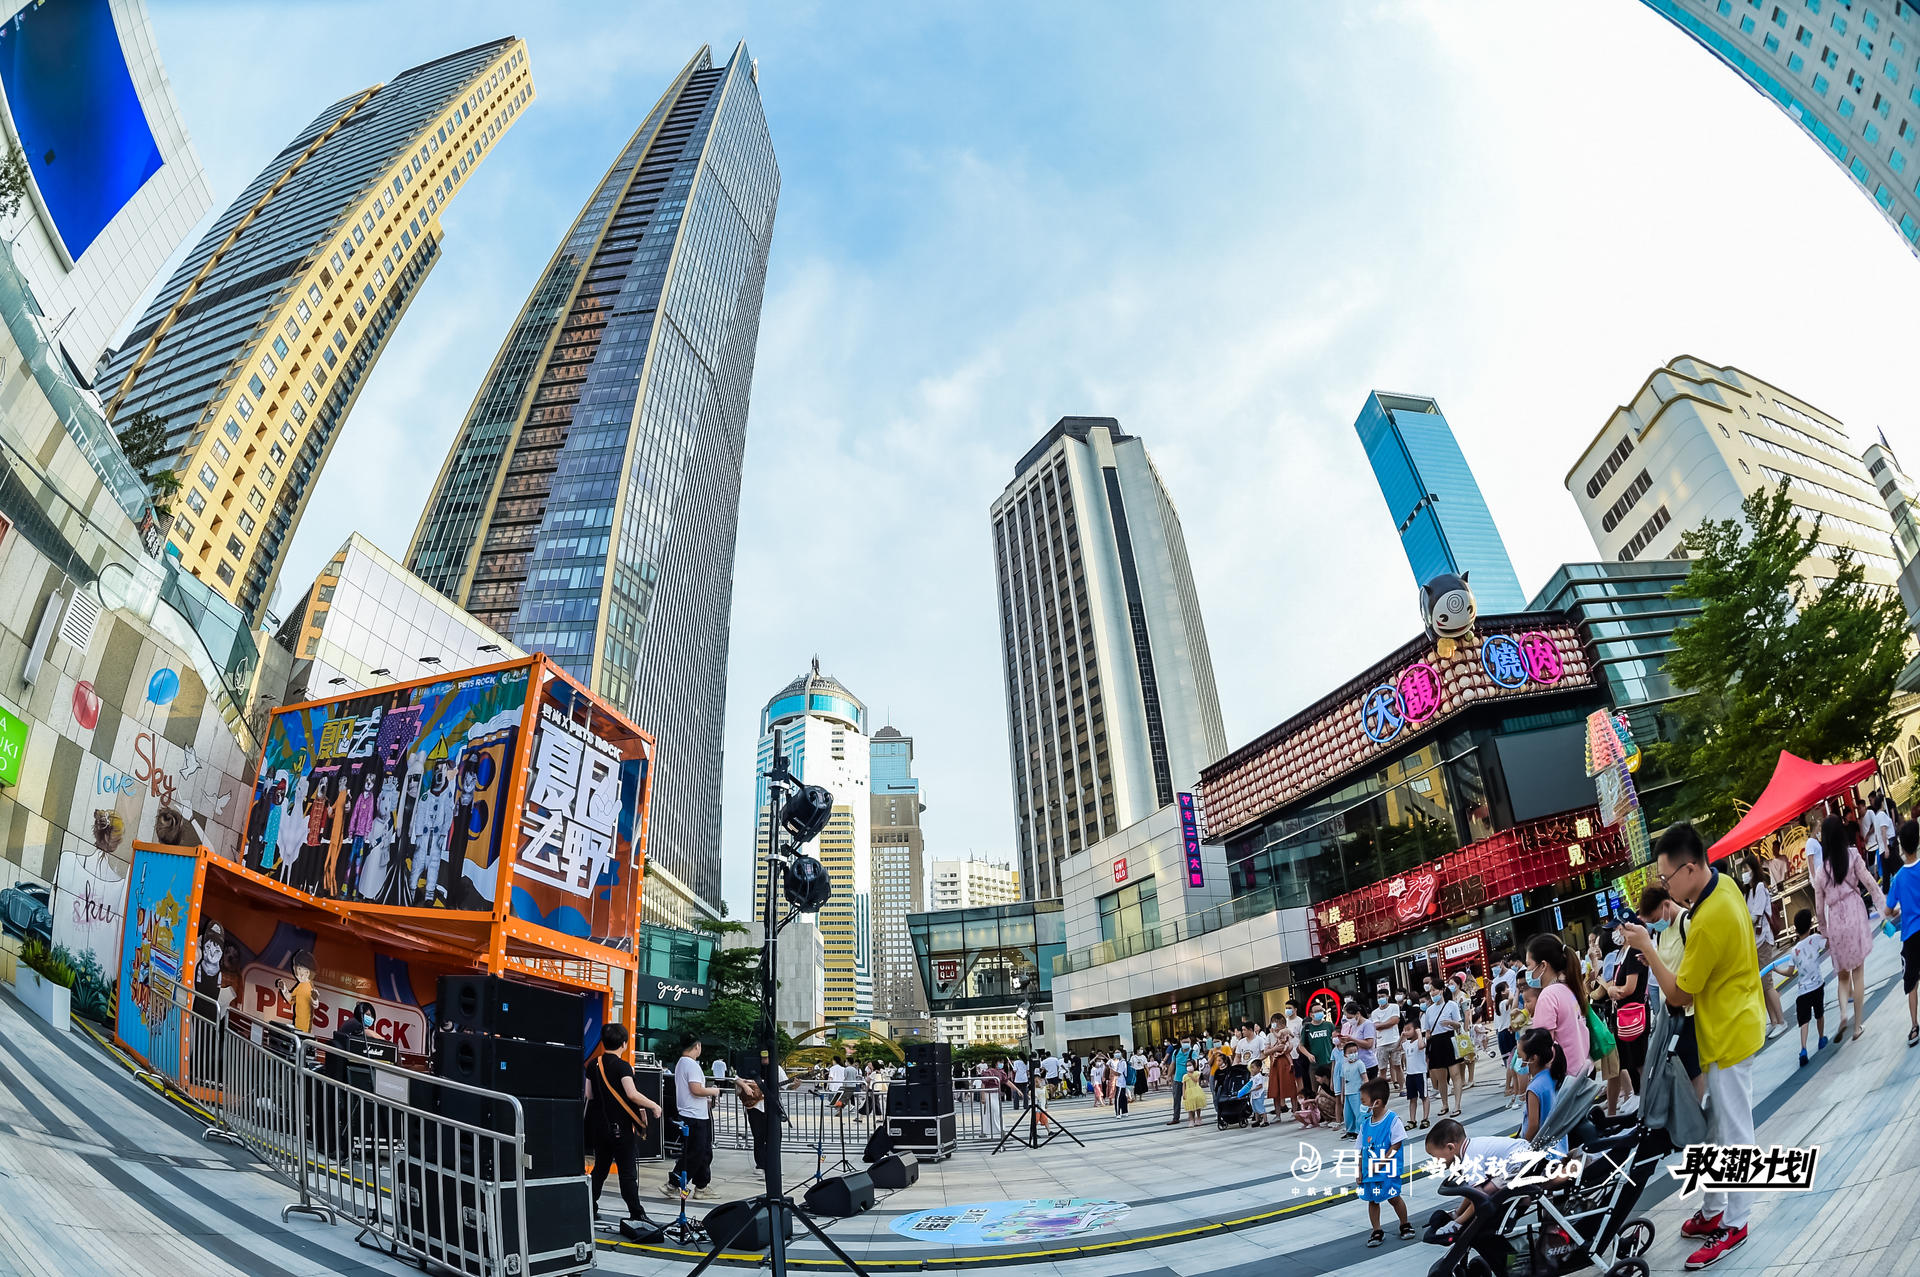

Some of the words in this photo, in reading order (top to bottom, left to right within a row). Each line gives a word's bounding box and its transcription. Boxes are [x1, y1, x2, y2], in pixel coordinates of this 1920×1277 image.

[458, 680, 474, 689] PETS
[475, 676, 496, 687] ROCK
[569, 719, 594, 744] PETS
[595, 735, 623, 761] ROCK
[134, 732, 177, 806] Sky
[96, 760, 137, 796] love
[1114, 860, 1125, 872] UNI
[1115, 869, 1127, 882] QLO
[939, 963, 956, 971] UNI
[939, 970, 956, 980] QLO
[255, 984, 330, 1029] PES
[337, 1007, 411, 1050] RCK
[1309, 1030, 1328, 1040] VANS
